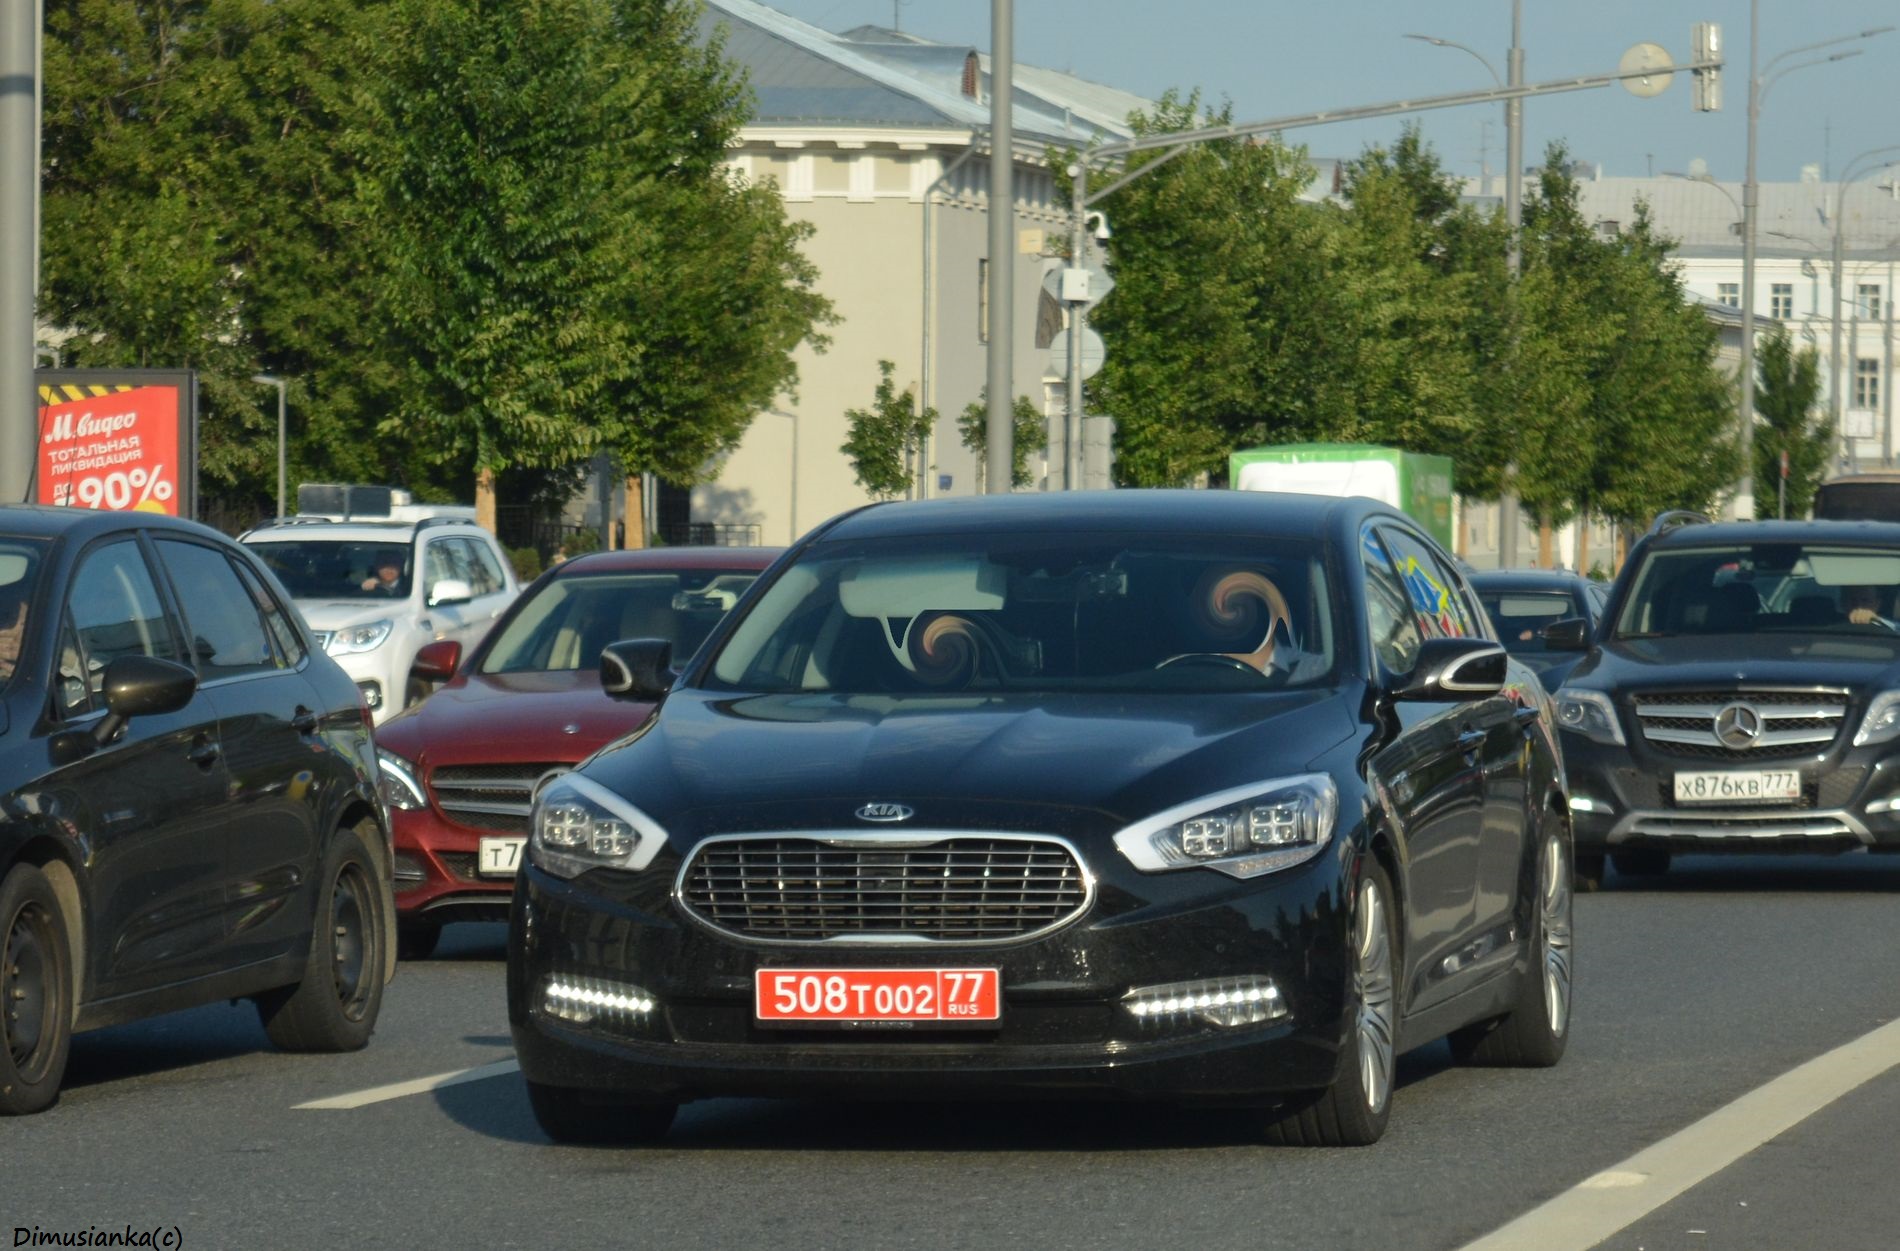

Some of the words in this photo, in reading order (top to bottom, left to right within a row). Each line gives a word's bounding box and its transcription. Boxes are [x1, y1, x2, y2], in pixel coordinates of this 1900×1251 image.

[47, 435, 140, 464] ТОТАЛЬНАЯ
[51, 449, 143, 476] ЛИКВИДАЦИЯ
[864, 804, 903, 818] KIA
[944, 973, 984, 1002] 77
[948, 1004, 978, 1015] RUS
